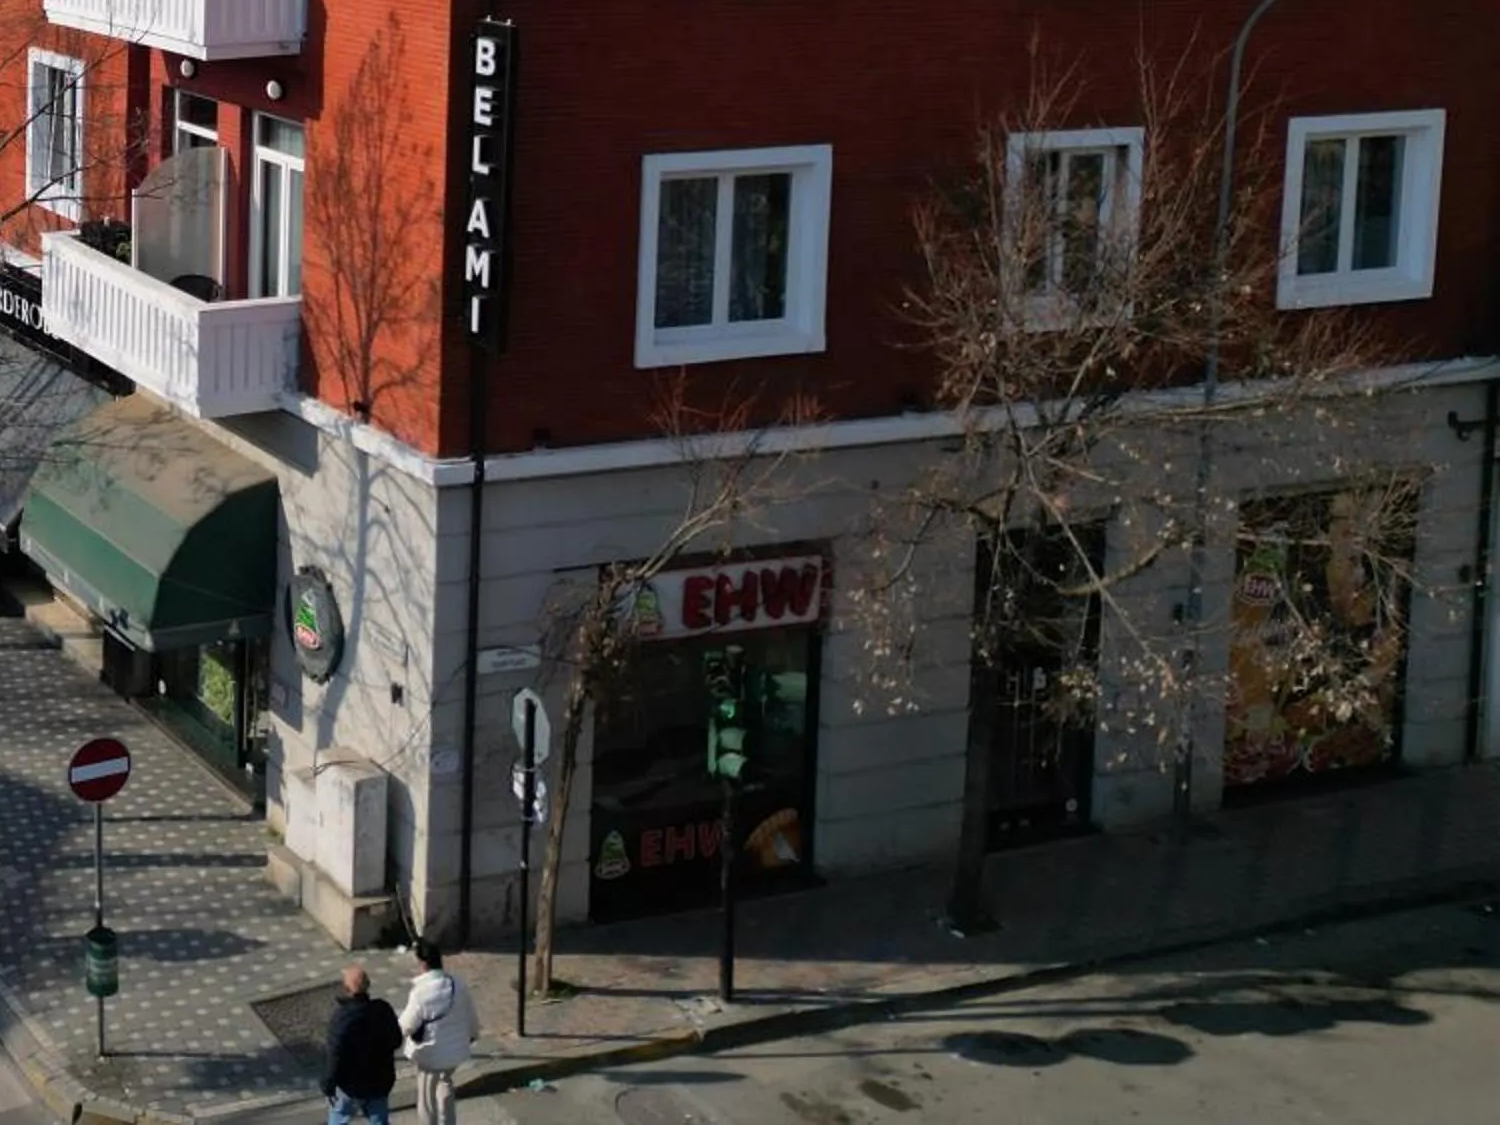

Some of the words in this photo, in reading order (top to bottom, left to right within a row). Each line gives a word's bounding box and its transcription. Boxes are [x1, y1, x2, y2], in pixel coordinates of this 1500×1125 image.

[471, 38, 496, 175] BEL
[465, 198, 490, 333] AMI
[682, 565, 819, 629] EHW
